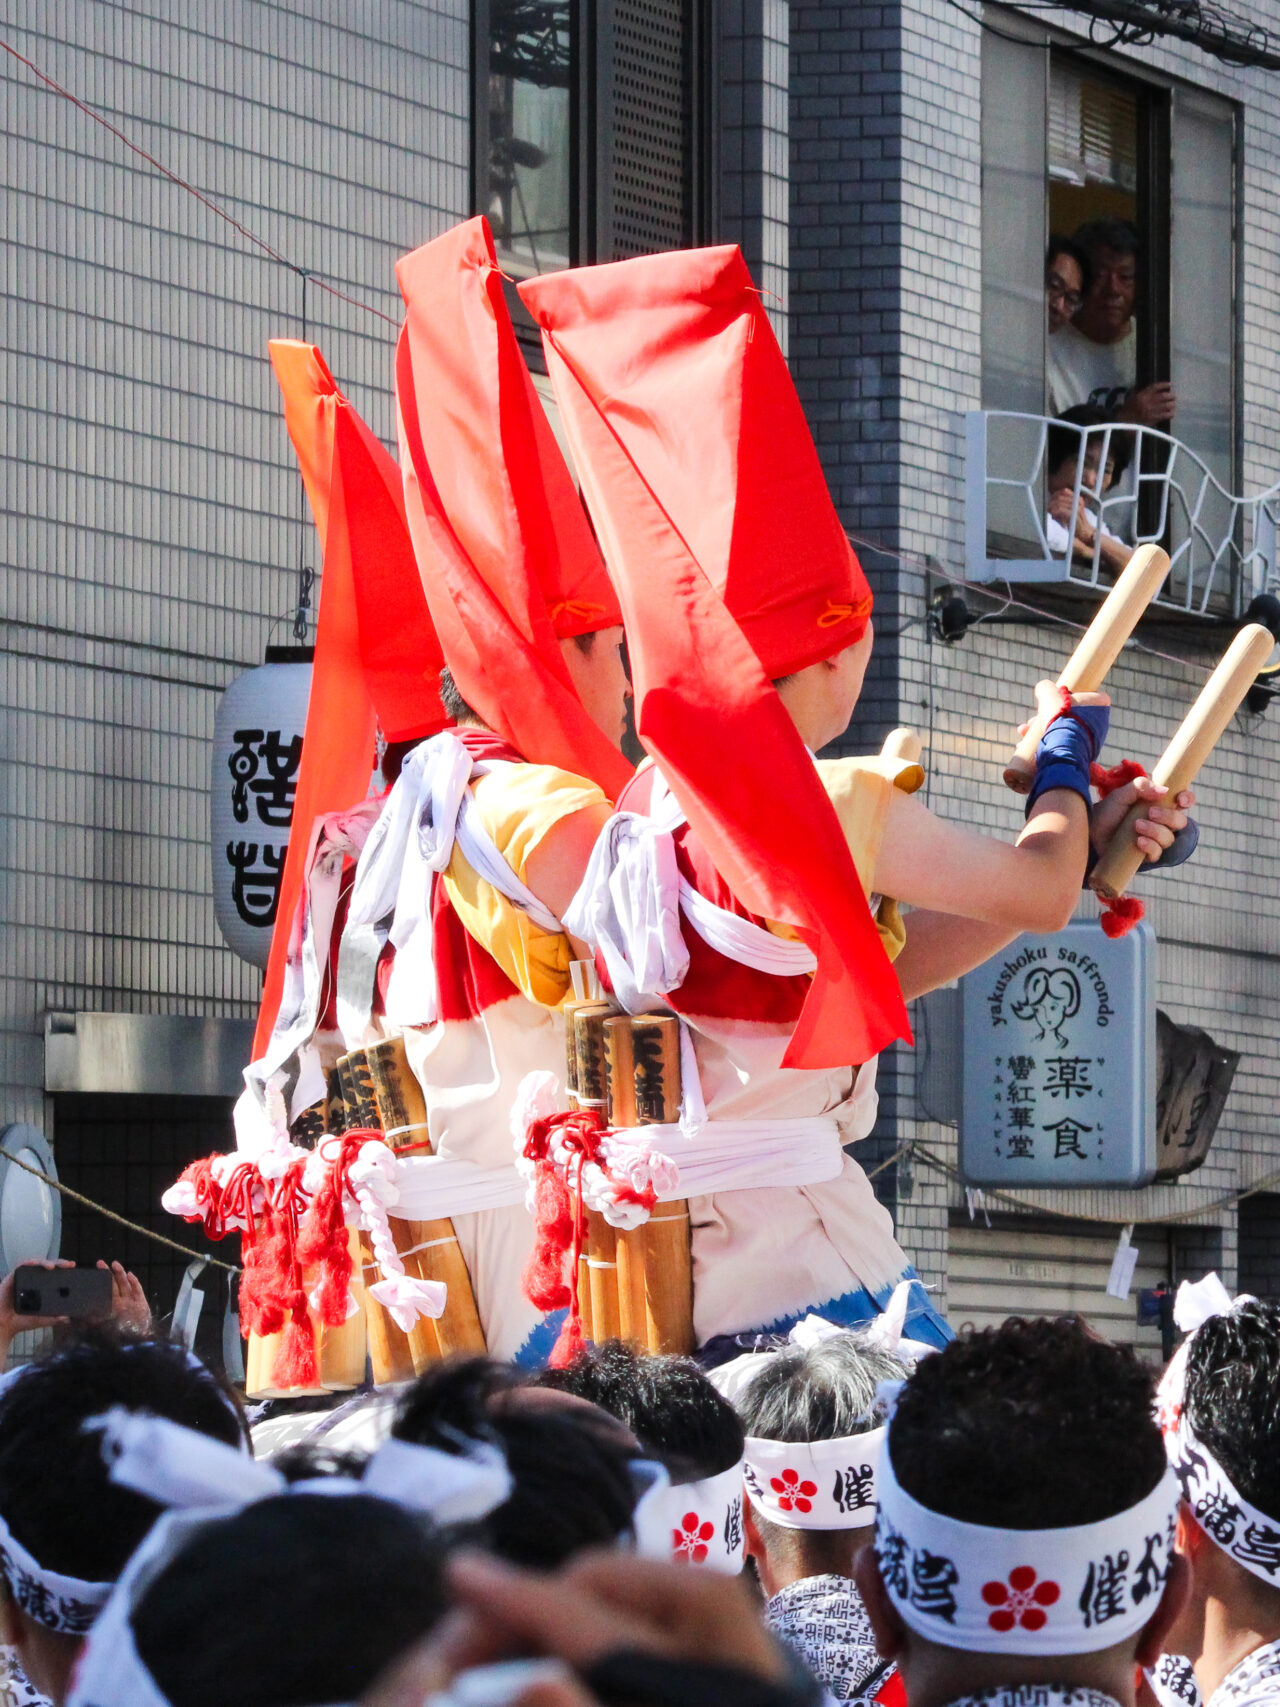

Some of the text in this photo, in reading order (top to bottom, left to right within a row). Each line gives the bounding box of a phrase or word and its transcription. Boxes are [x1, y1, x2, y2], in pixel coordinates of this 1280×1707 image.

[987, 947, 1114, 1027] yakushoku saffrondo
[1042, 1055, 1093, 1160] 薬食
